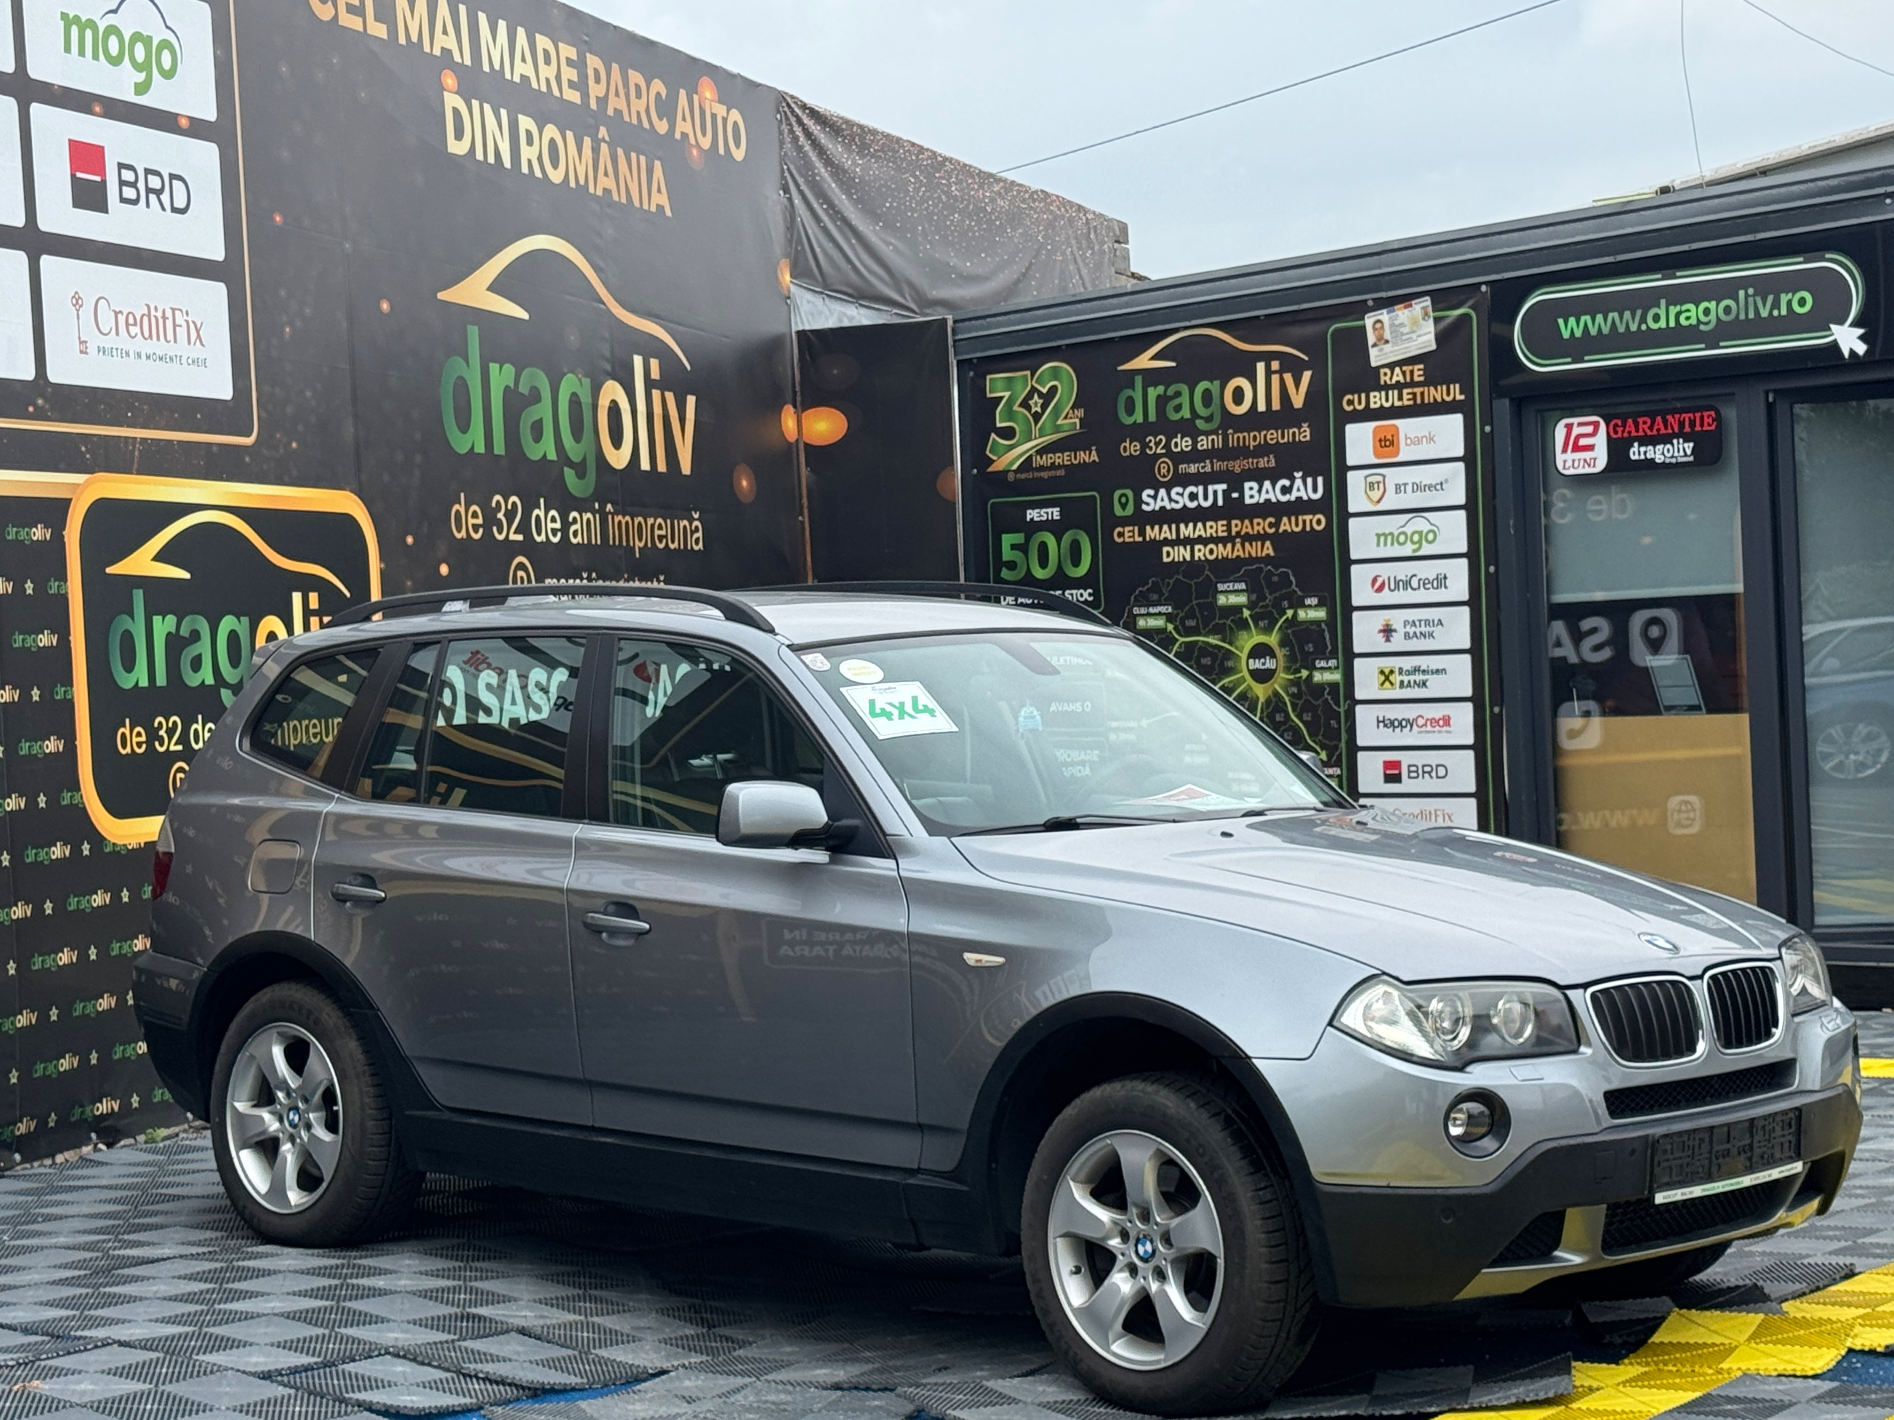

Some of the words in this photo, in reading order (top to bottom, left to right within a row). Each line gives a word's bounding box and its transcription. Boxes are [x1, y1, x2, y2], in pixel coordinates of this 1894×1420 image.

[60, 11, 178, 96] mogo
[396, 0, 471, 67] MAI
[477, 11, 581, 102] MARE
[586, 53, 669, 135] PARC
[675, 88, 747, 162] AUTO
[442, 91, 511, 170] DIN
[517, 114, 672, 217] ROMÂNIA
[117, 161, 191, 215] BRD
[93, 296, 205, 348] CreditFix
[1557, 287, 1813, 340] www.dragoliv.ro
[97, 345, 130, 359] PRIETEN
[134, 350, 142, 360] IN
[145, 352, 183, 366] MOMENTE
[186, 356, 208, 368] CHEIE
[1379, 364, 1425, 385] RATE
[1117, 361, 1313, 430] dragoliv
[1342, 393, 1366, 412] CU
[1369, 383, 1465, 409] BULETINUL
[440, 325, 696, 498] dragoliv
[985, 361, 1080, 459] 32
[1068, 408, 1085, 420] ANI
[1608, 410, 1717, 438] GARANTIE
[1120, 438, 1141, 457] de
[1146, 435, 1167, 454] 32
[1171, 433, 1192, 453] de
[1197, 431, 1223, 450] ani
[1228, 423, 1310, 450] împreună
[1378, 434, 1395, 449] tbi
[1404, 431, 1436, 446] bank
[1561, 420, 1600, 455] 12
[1032, 446, 1099, 468] ÎMPREUNĂ
[1629, 438, 1694, 463] dragoliv
[1179, 459, 1212, 475] marcă
[1213, 456, 1276, 472] înregistrată
[1562, 457, 1597, 471] LUNI
[1141, 484, 1227, 512] SASCUT
[1244, 472, 1324, 506] BACĂU
[1368, 481, 1382, 492] BT
[1394, 483, 1409, 495] BT
[450, 492, 484, 541] de
[491, 494, 524, 542] 32
[531, 498, 562, 544] de
[568, 503, 601, 546] ani
[606, 504, 704, 558] împreună
[1026, 508, 1061, 522] PESTE
[5, 523, 51, 544] dragoliv
[1113, 525, 1143, 543] CEL
[1146, 522, 1176, 541] MAI
[1179, 519, 1228, 538] MARE
[1231, 516, 1278, 536] PARC
[1279, 513, 1326, 533] AUTO
[1162, 545, 1191, 563] DIN
[1194, 540, 1274, 561] ROMÂNIA
[1375, 529, 1438, 554] mogo
[1000, 529, 1092, 581] 500
[1217, 582, 1246, 591] SUCEAVA
[1387, 573, 1448, 592] UniCredit
[1064, 588, 1094, 602] STOC
[1403, 618, 1444, 629] PATRIA
[1404, 629, 1436, 641] BANK
[11, 629, 58, 651] dragoliv
[1249, 656, 1276, 670] BACĂU
[1398, 666, 1447, 677] Raiffeisen
[1398, 678, 1429, 690] BANK
[1049, 702, 1082, 712] AVANS
[1376, 714, 1452, 733] HappyCredit
[18, 735, 64, 757] dragoliv
[116, 718, 147, 755] de
[154, 716, 183, 752] 32
[1407, 763, 1448, 779] BRD
[25, 841, 71, 864] dragoliv
[66, 889, 111, 912] dragoliv
[109, 934, 151, 957] dragoliv
[31, 947, 78, 971] dragoliv
[72, 993, 117, 1017] dragoliv
[32, 1053, 79, 1078] dragoliv
[70, 1097, 120, 1122] dragoliv
